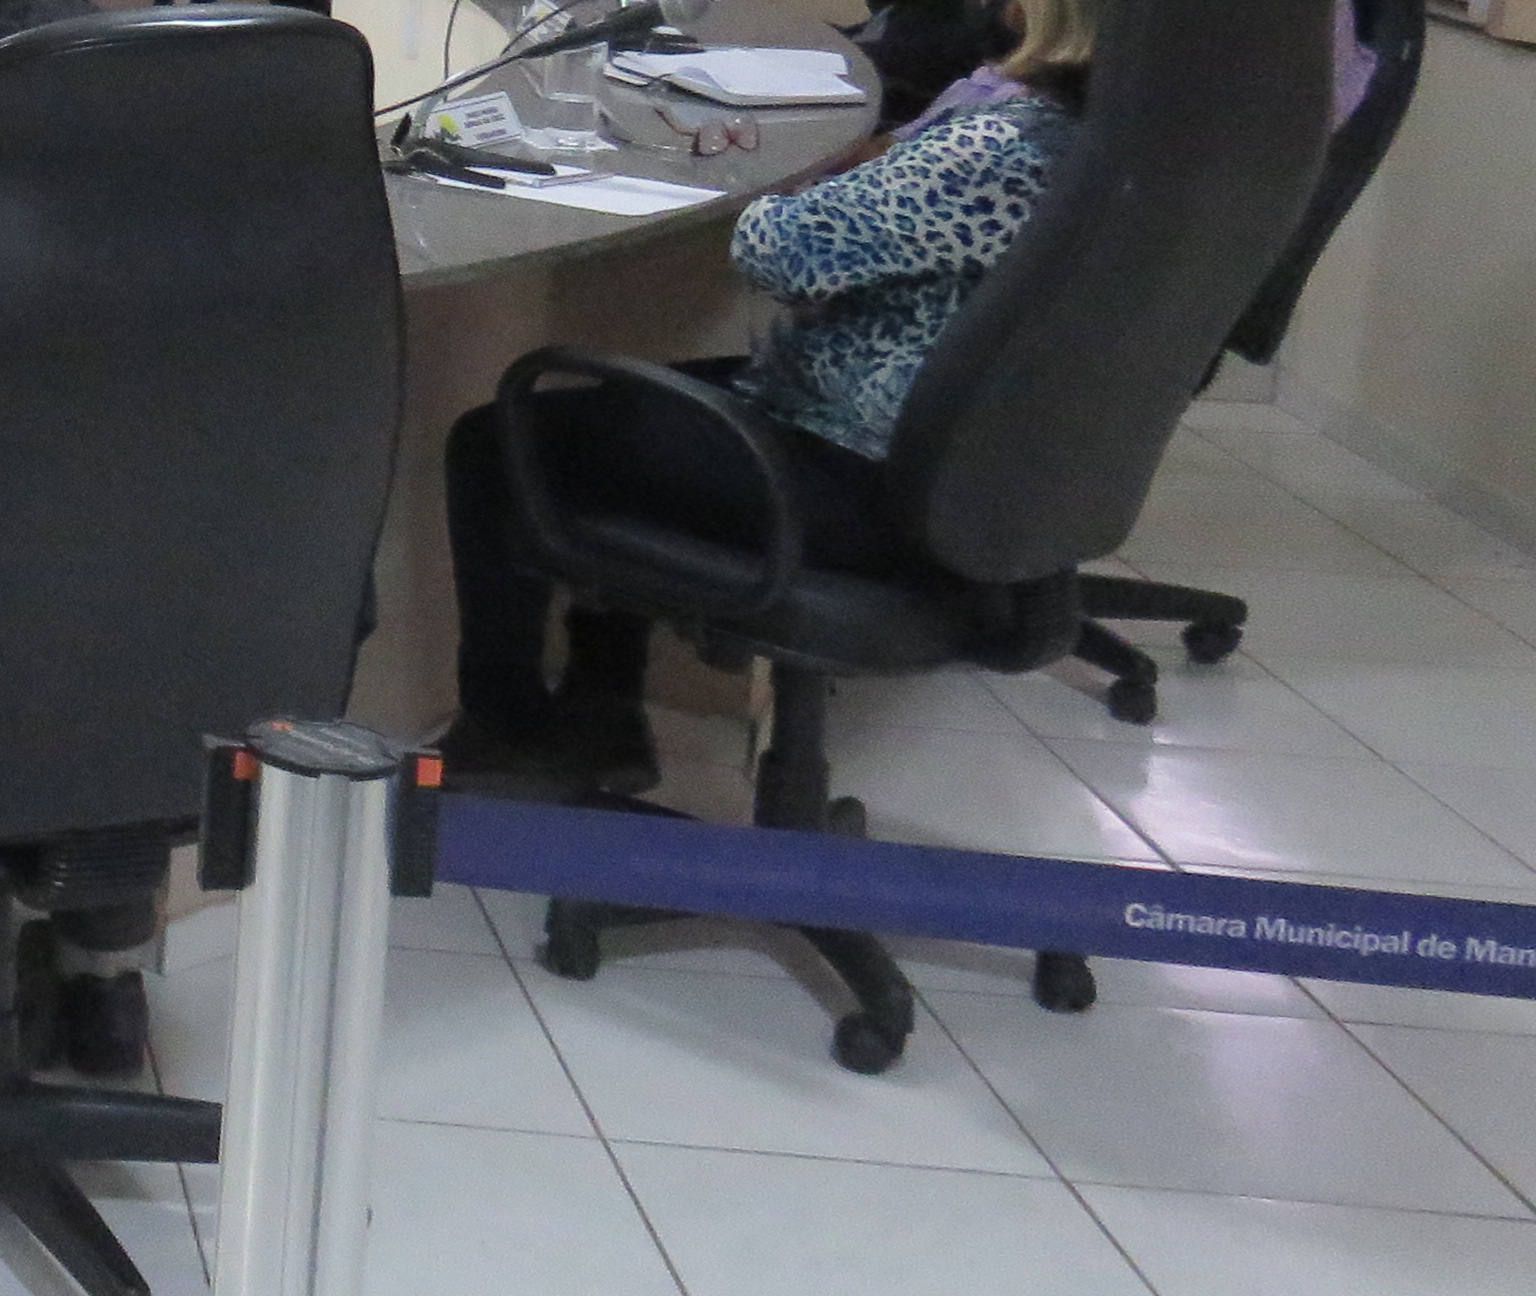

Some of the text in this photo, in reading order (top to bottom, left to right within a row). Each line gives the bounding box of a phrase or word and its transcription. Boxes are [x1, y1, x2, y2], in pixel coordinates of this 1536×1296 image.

[1125, 903, 1247, 939] Câmara
[1254, 917, 1409, 956] Municipal
[1416, 934, 1456, 959] de
